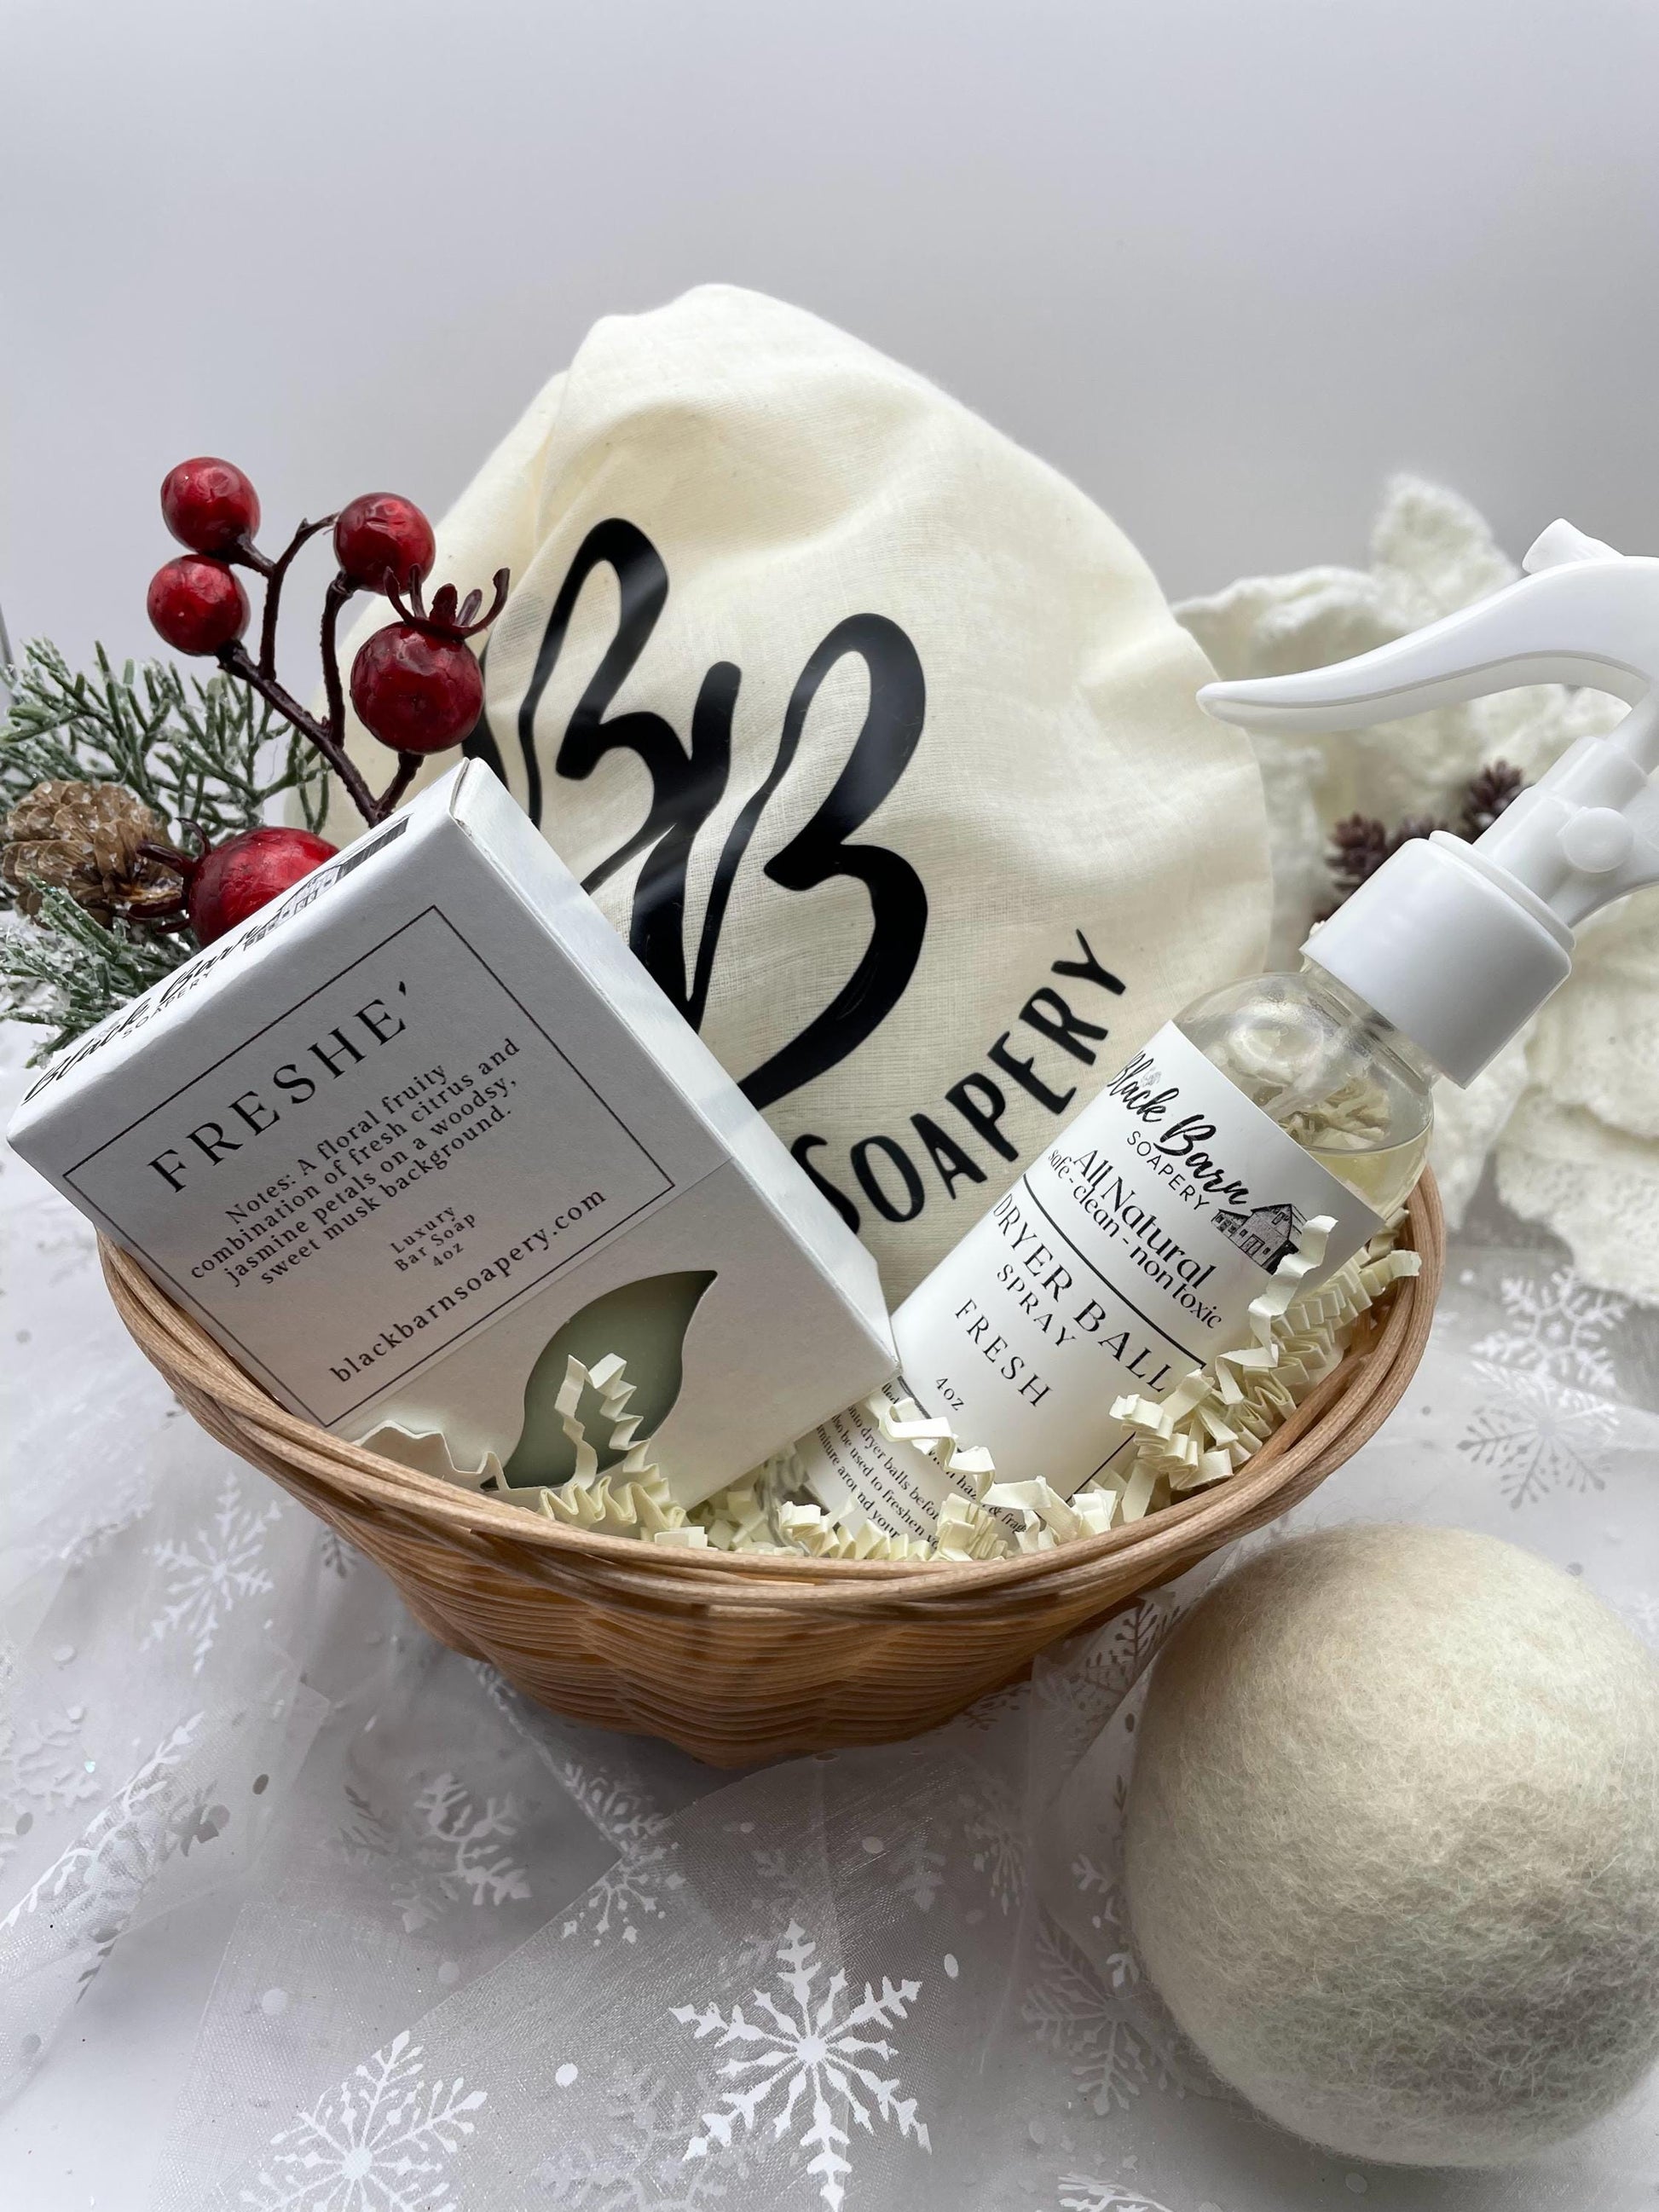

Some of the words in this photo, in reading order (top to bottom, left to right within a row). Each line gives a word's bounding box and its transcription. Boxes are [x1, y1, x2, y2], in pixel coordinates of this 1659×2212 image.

[123, 969, 213, 1038] SOAPERY
[21, 997, 151, 1106] Black
[791, 929, 1126, 1234] SOAPERY
[191, 1185, 321, 1279] combination
[324, 1159, 348, 1185] of
[349, 1122, 408, 1166] fresh
[411, 1074, 474, 1123] citrus
[478, 1038, 520, 1075] and
[224, 1173, 297, 1224] Notes:
[298, 1158, 317, 1176] A
[316, 1110, 380, 1160] floral
[381, 1065, 448, 1114] fruity
[224, 1219, 309, 1287] jasmine
[312, 1173, 377, 1225] petals
[380, 1151, 408, 1173] on
[413, 1137, 427, 1151] a
[431, 1077, 517, 1135] woodsy,
[1127, 1130, 1210, 1211] SOAPERY
[1153, 1114, 1250, 1204] Barn
[261, 1239, 321, 1285] sweet
[323, 1198, 381, 1241] musk
[378, 1107, 512, 1198] background.
[390, 1207, 456, 1254] Luxury
[1048, 1149, 1072, 1178] safe
[1072, 1184, 1120, 1239] clean
[1072, 1150, 1114, 1188] All
[1101, 1176, 1217, 1290] Natural
[330, 1191, 606, 1383] blackbarnsoapery.com
[394, 1247, 427, 1272] Bar
[431, 1213, 476, 1247] Soap
[432, 1243, 465, 1268] 4oz
[993, 1193, 1073, 1302] DRYER
[1072, 1298, 1172, 1393] BALL
[997, 1263, 1077, 1348] SPRAY
[935, 1377, 965, 1411] 4oz
[955, 1297, 1052, 1407] FRESH
[840, 1429, 853, 1447] be
[849, 1447, 874, 1477] used
[870, 1476, 883, 1492] to
[882, 1489, 925, 1536] freshen
[860, 1427, 887, 1459] dryer
[883, 1456, 910, 1491] balls
[909, 1487, 939, 1520] befor
[867, 1510, 901, 1539] your
[1001, 1512, 1027, 1534] frag
